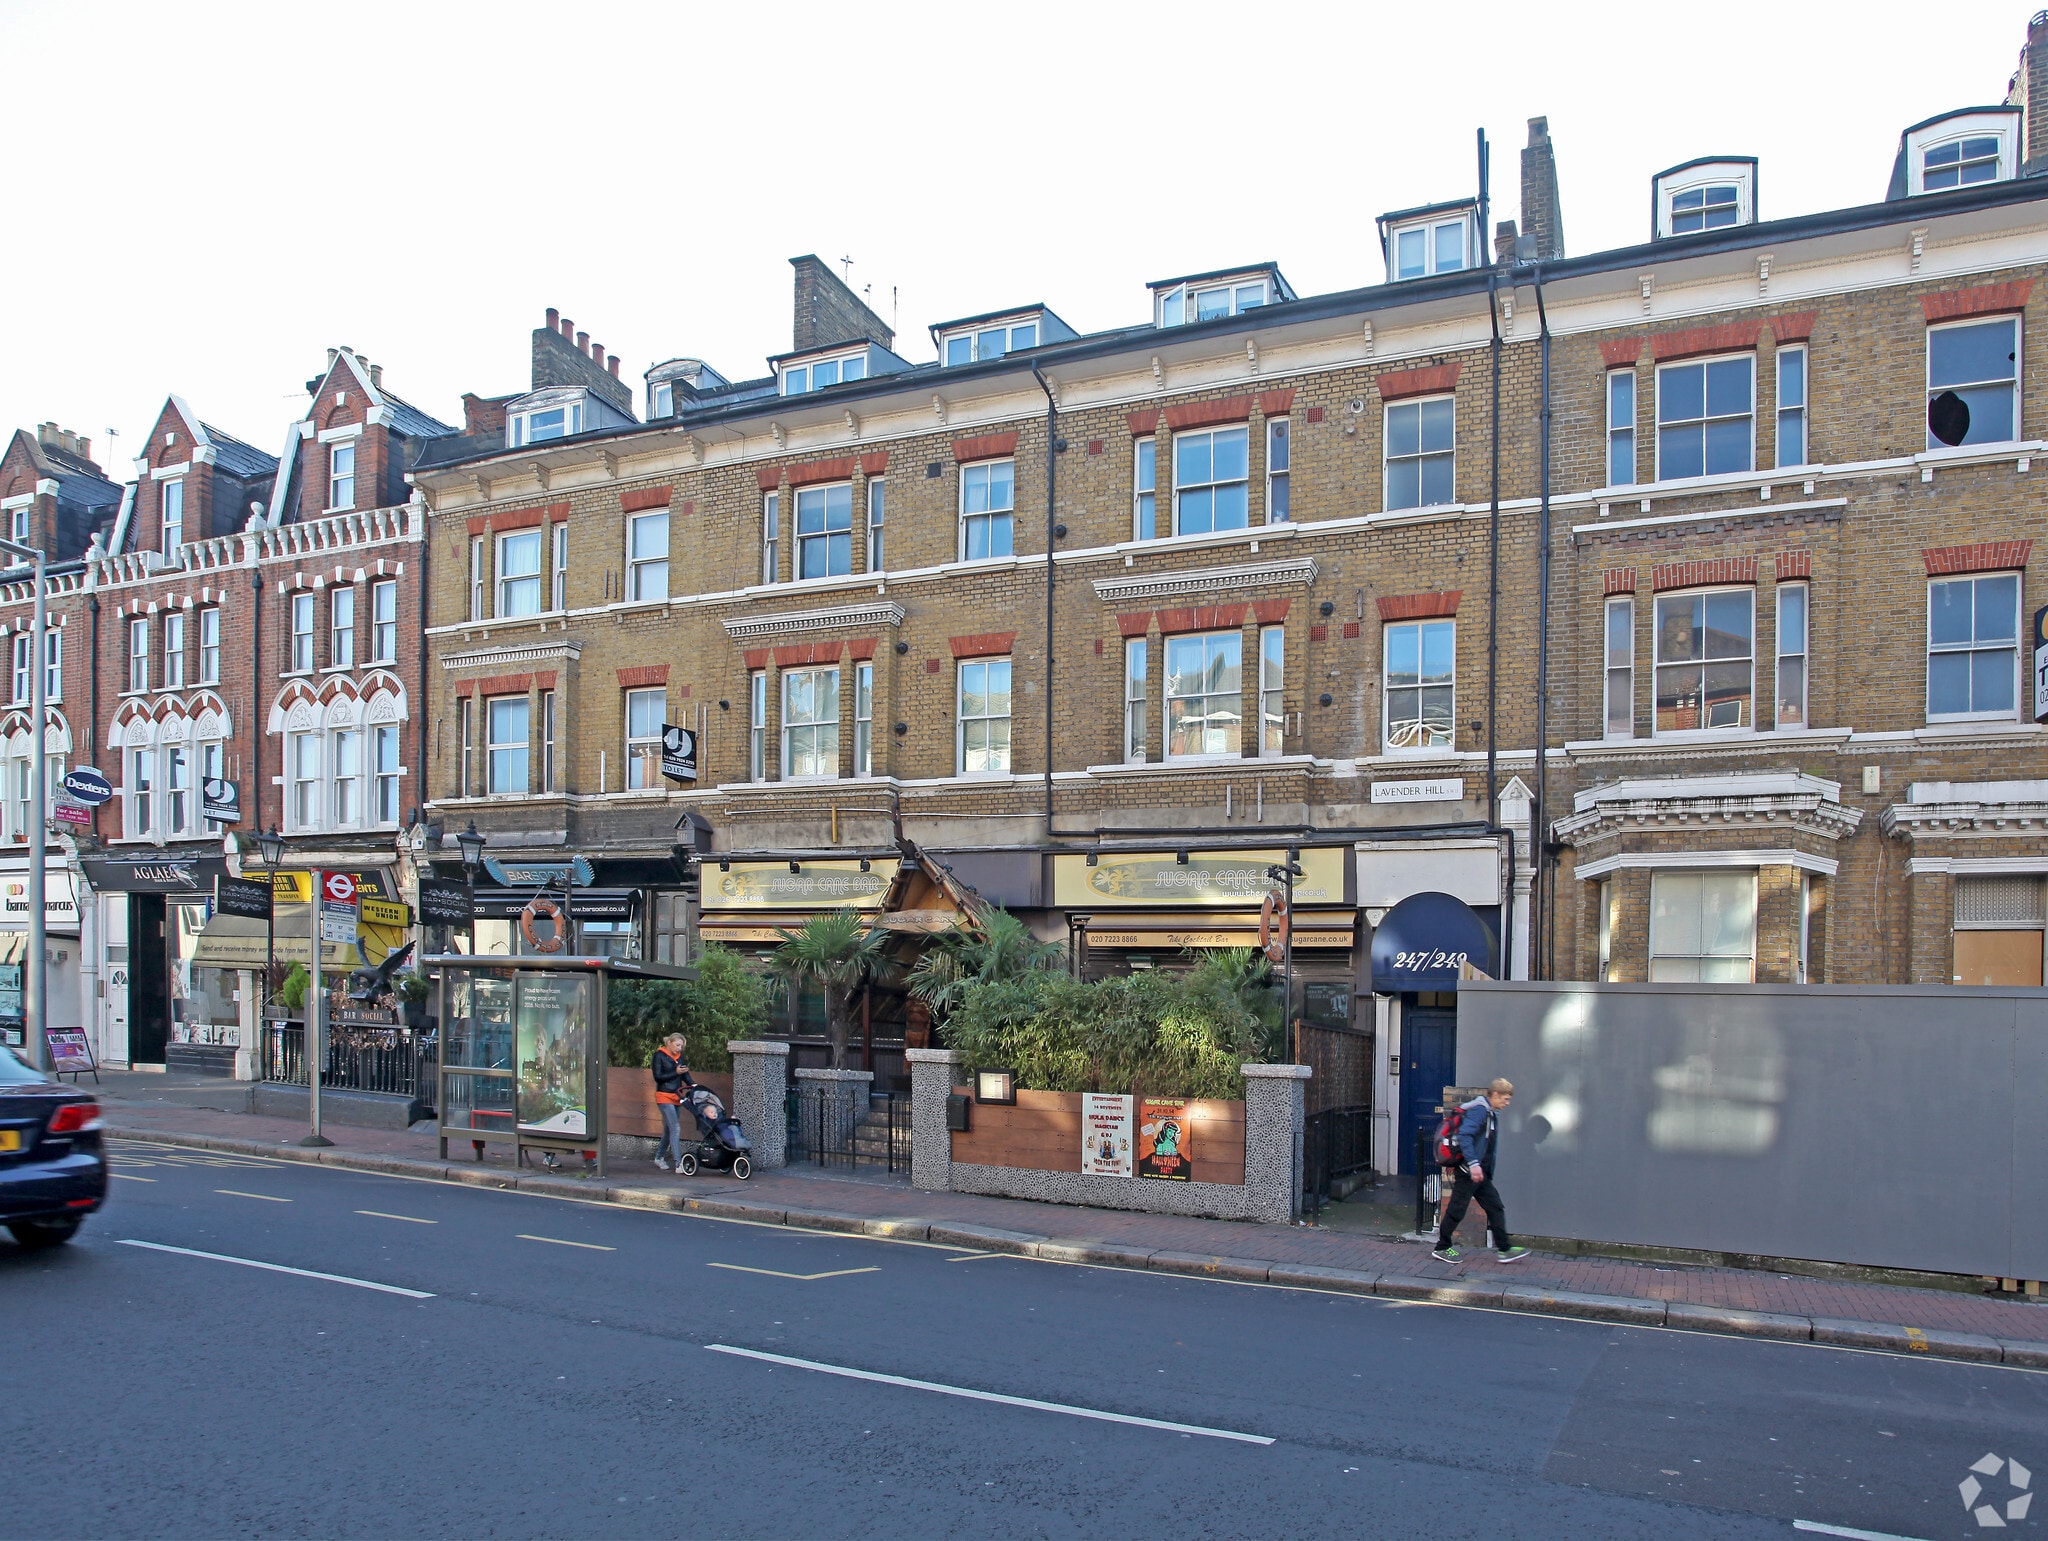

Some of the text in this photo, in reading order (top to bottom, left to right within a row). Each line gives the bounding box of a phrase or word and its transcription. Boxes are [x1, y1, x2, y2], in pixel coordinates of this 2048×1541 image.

[66, 777, 110, 796] Dexters
[1375, 787, 1421, 797] LAVENDER
[1425, 785, 1445, 795] HILL
[1155, 870, 1210, 891] SUGAR
[1215, 869, 1256, 890] CANE
[770, 877, 880, 896] SUGAR CANE BAR
[240, 894, 268, 903] SOCIAL
[422, 895, 469, 908] BAR SOCIAL
[733, 895, 748, 903] 7223
[363, 904, 399, 915] WESTERN
[375, 912, 399, 920] UNION
[882, 916, 922, 925] SUGAR
[1090, 935, 1103, 943] 020
[1104, 935, 1120, 943] 7223
[1121, 935, 1138, 943] 8866
[1167, 934, 1181, 943] Tiki
[1183, 934, 1213, 944] Cocktail
[1215, 934, 1229, 943] Bar
[201, 944, 214, 952] Send
[1392, 947, 1468, 972] 247/249
[343, 1011, 384, 1021] BAR SOCIAL
[1151, 1155, 1181, 1168] HALLOWEEN
[1160, 1167, 1174, 1175] PARTY
